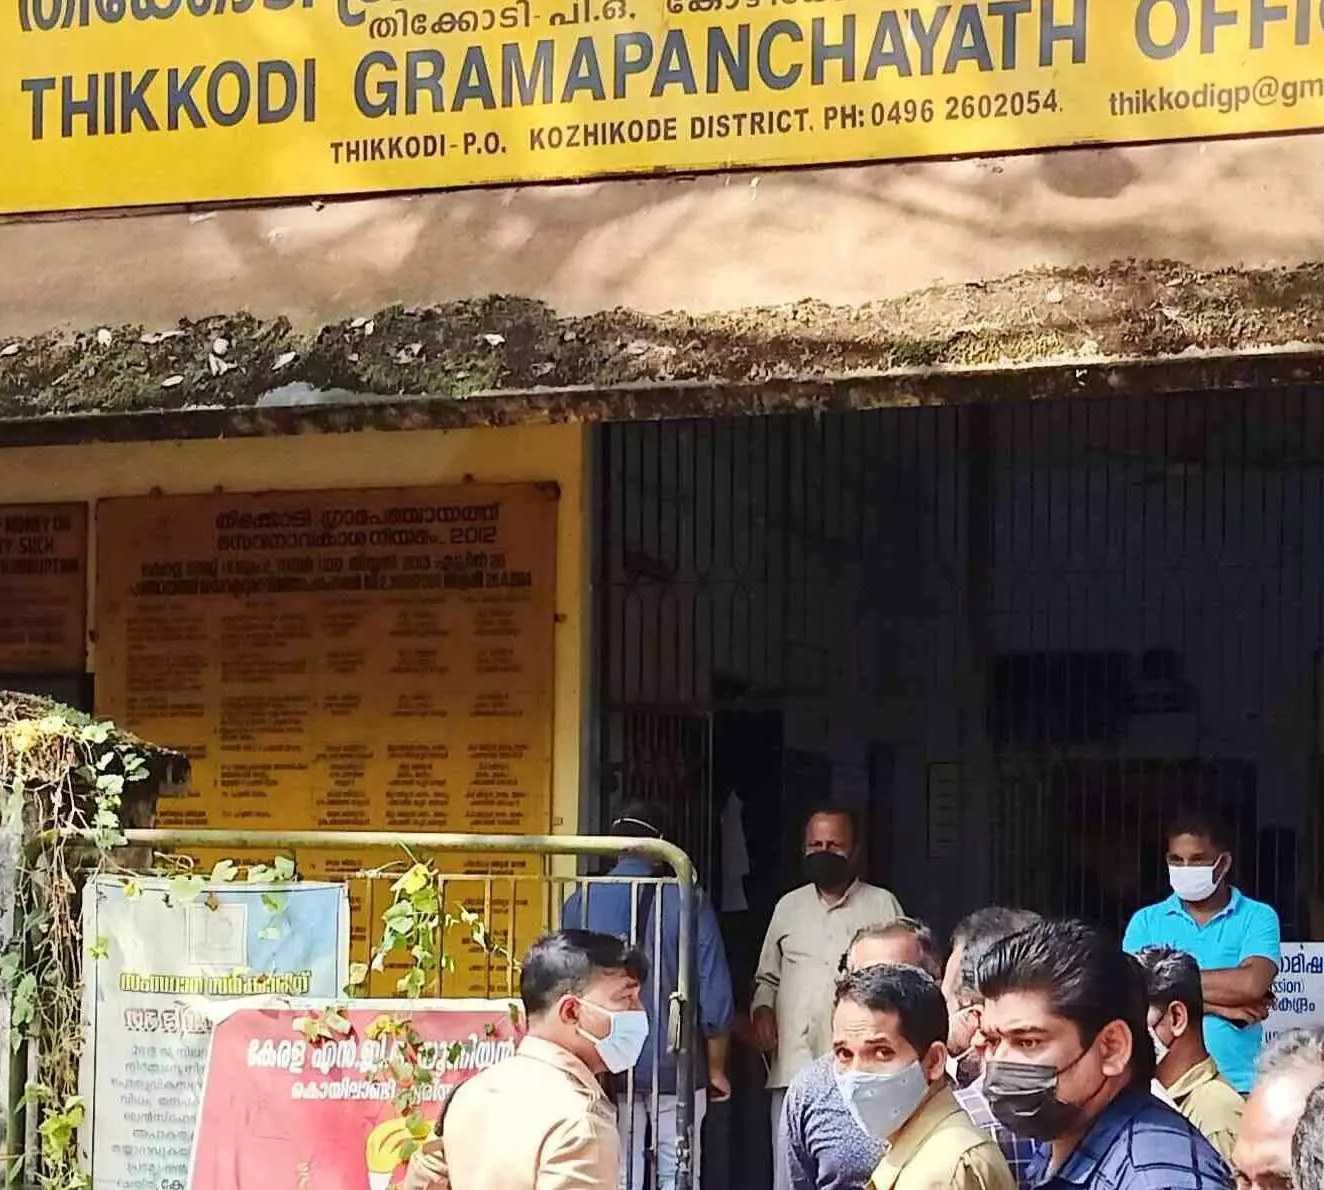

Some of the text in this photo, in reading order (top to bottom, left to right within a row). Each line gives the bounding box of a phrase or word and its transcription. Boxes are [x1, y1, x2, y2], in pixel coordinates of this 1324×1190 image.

[20, 58, 317, 141] THIKKODI
[354, 0, 1087, 118] GRAMAPANCHAYATH
[530, 117, 677, 152] KOZHIKODE
[450, 526, 498, 544] 2012
[247, 1039, 308, 1074] കേരള
